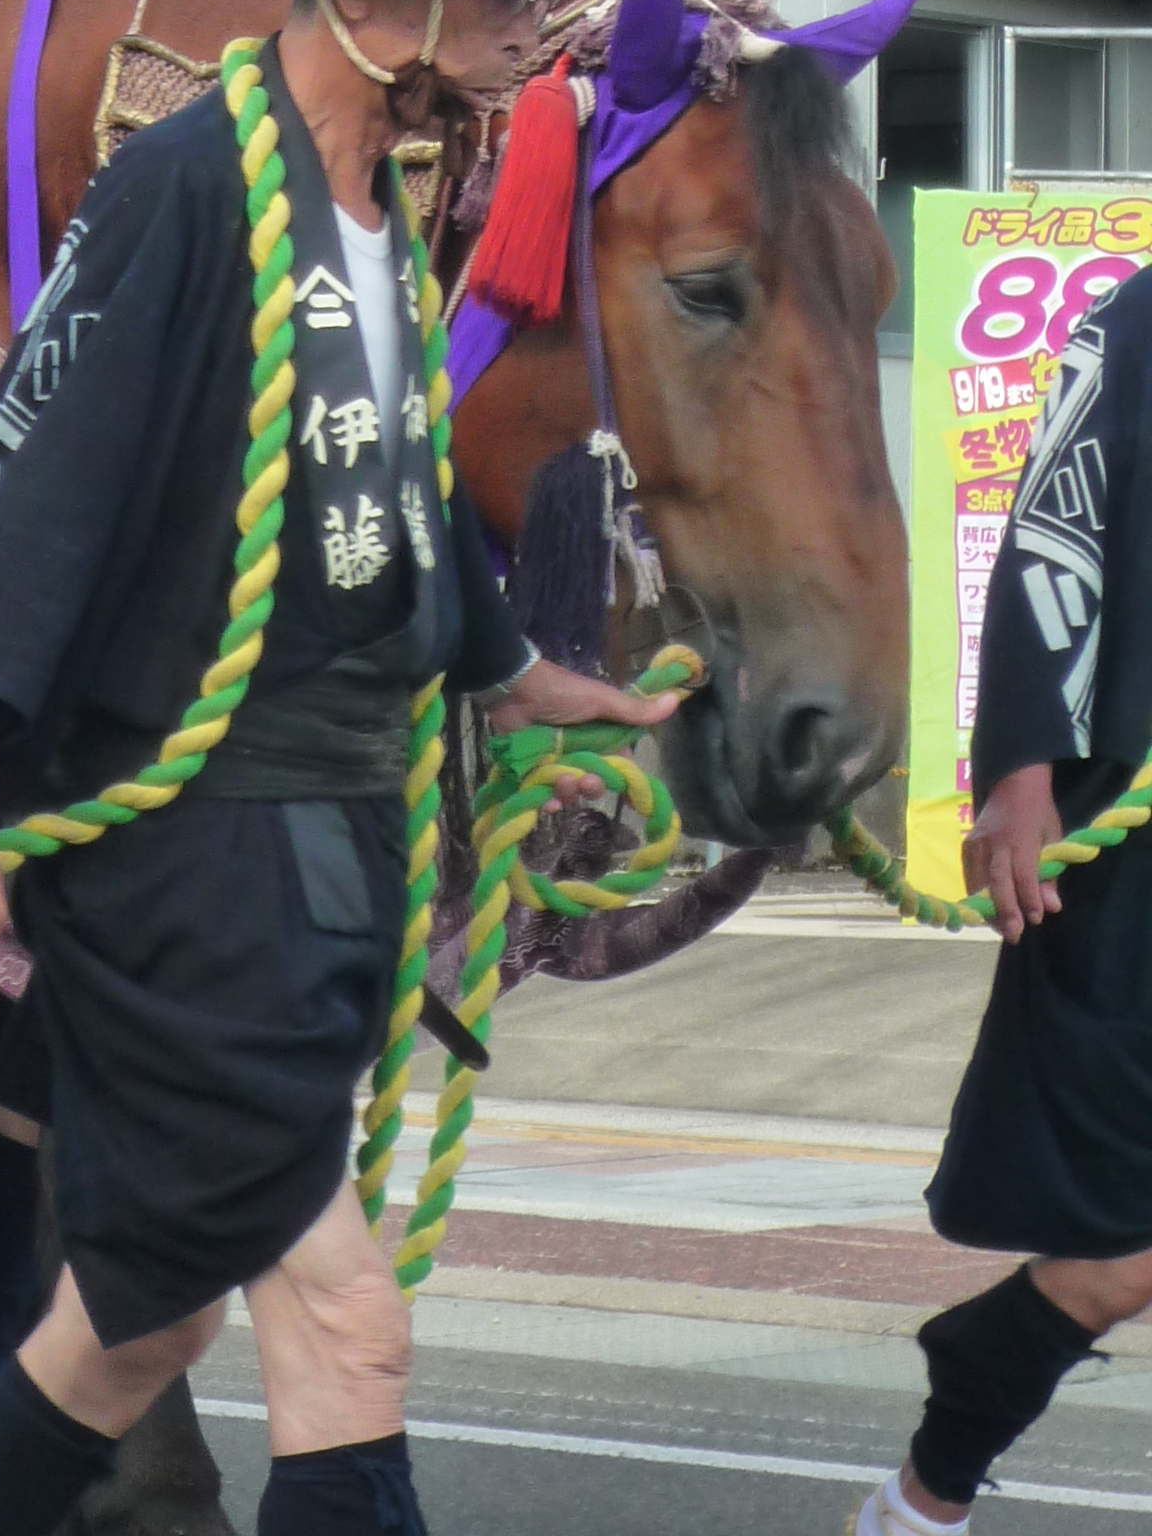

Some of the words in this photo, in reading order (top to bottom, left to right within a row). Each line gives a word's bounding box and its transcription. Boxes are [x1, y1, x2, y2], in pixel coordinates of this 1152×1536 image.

[962, 198, 1152, 255] ドライ品3
[959, 415, 1038, 470] 冬物
